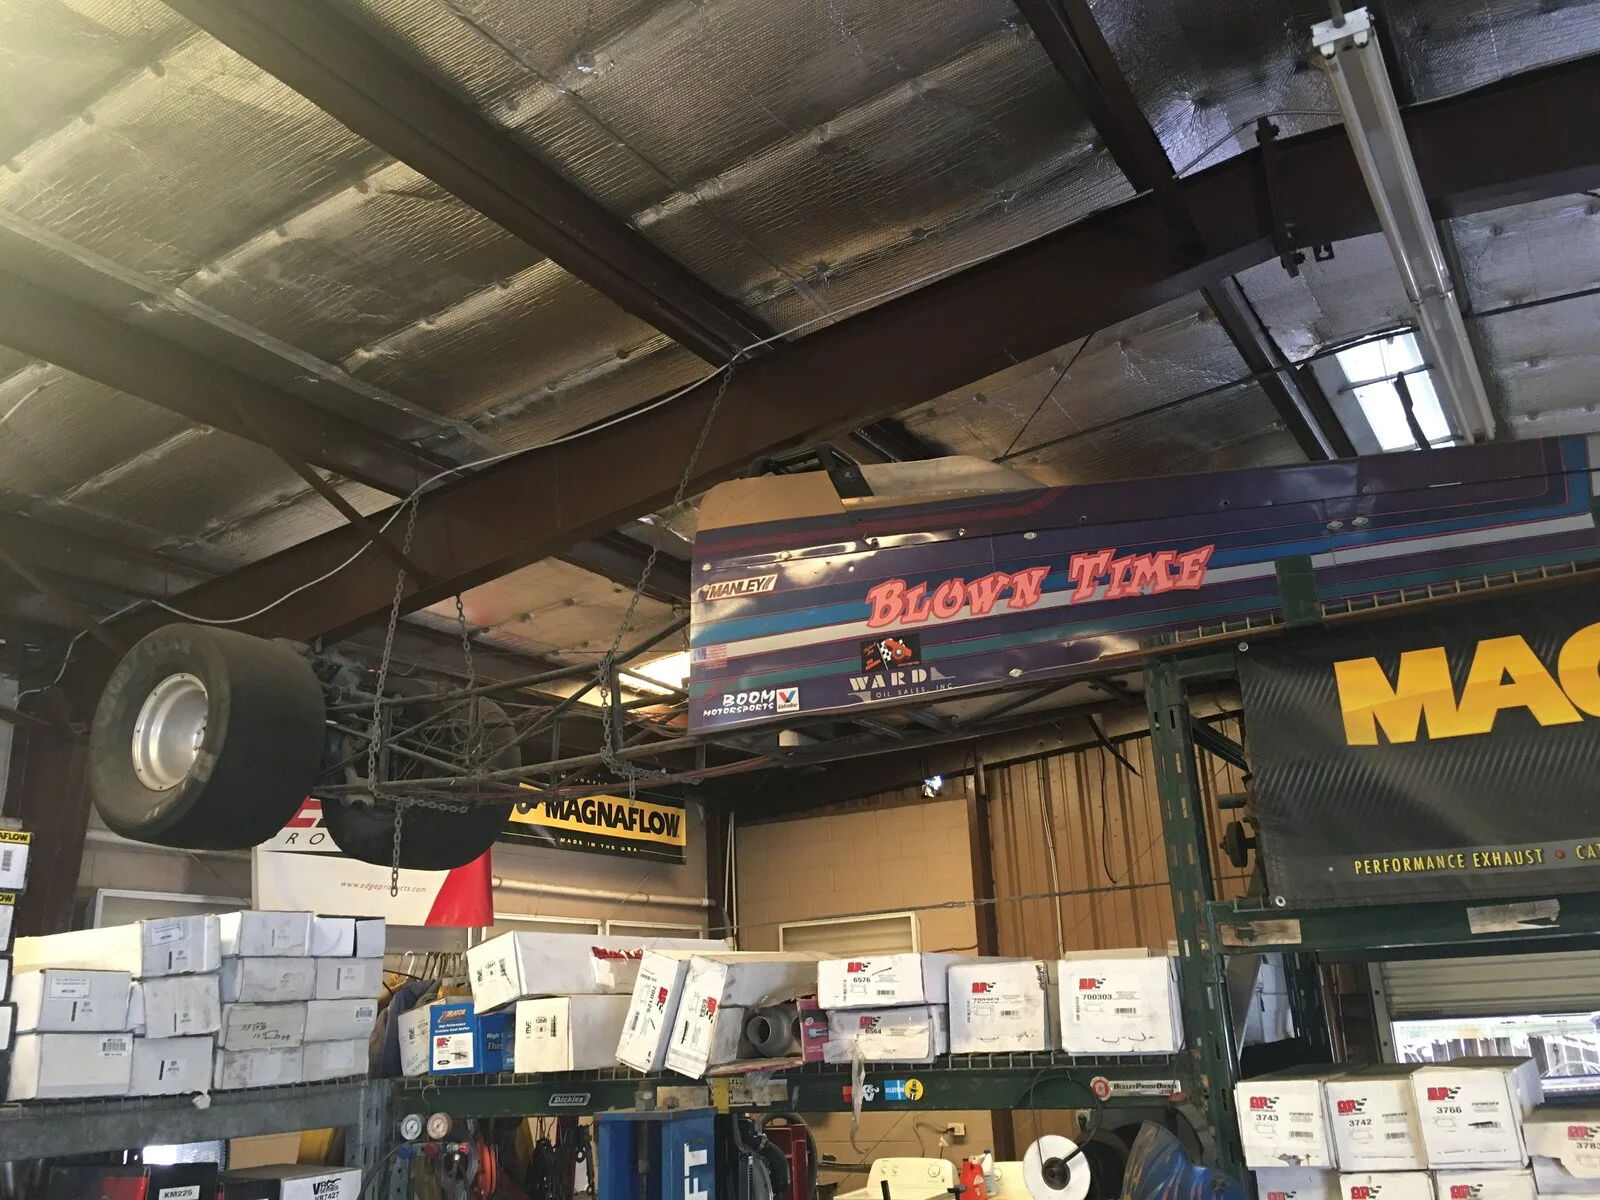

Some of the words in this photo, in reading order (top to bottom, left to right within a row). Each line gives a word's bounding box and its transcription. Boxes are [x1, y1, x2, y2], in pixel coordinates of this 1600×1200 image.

[708, 579, 764, 599] MANLEY
[867, 566, 1051, 629] BLOWN
[1069, 545, 1215, 605] TIME
[849, 668, 927, 691] WARD
[722, 690, 776, 706] BOOM
[703, 702, 774, 717] MOTORSPORTS
[544, 798, 680, 838] MAGNAFLOW
[560, 837, 583, 845] MADE
[1354, 853, 1465, 875] PERFORMANCE
[1472, 848, 1544, 868] EXHAUST
[341, 881, 427, 893] www.edgeproucts.com
[1436, 1106, 1462, 1114] 3766
[1348, 1118, 1373, 1127] 3742
[164, 1189, 193, 1199] KM225
